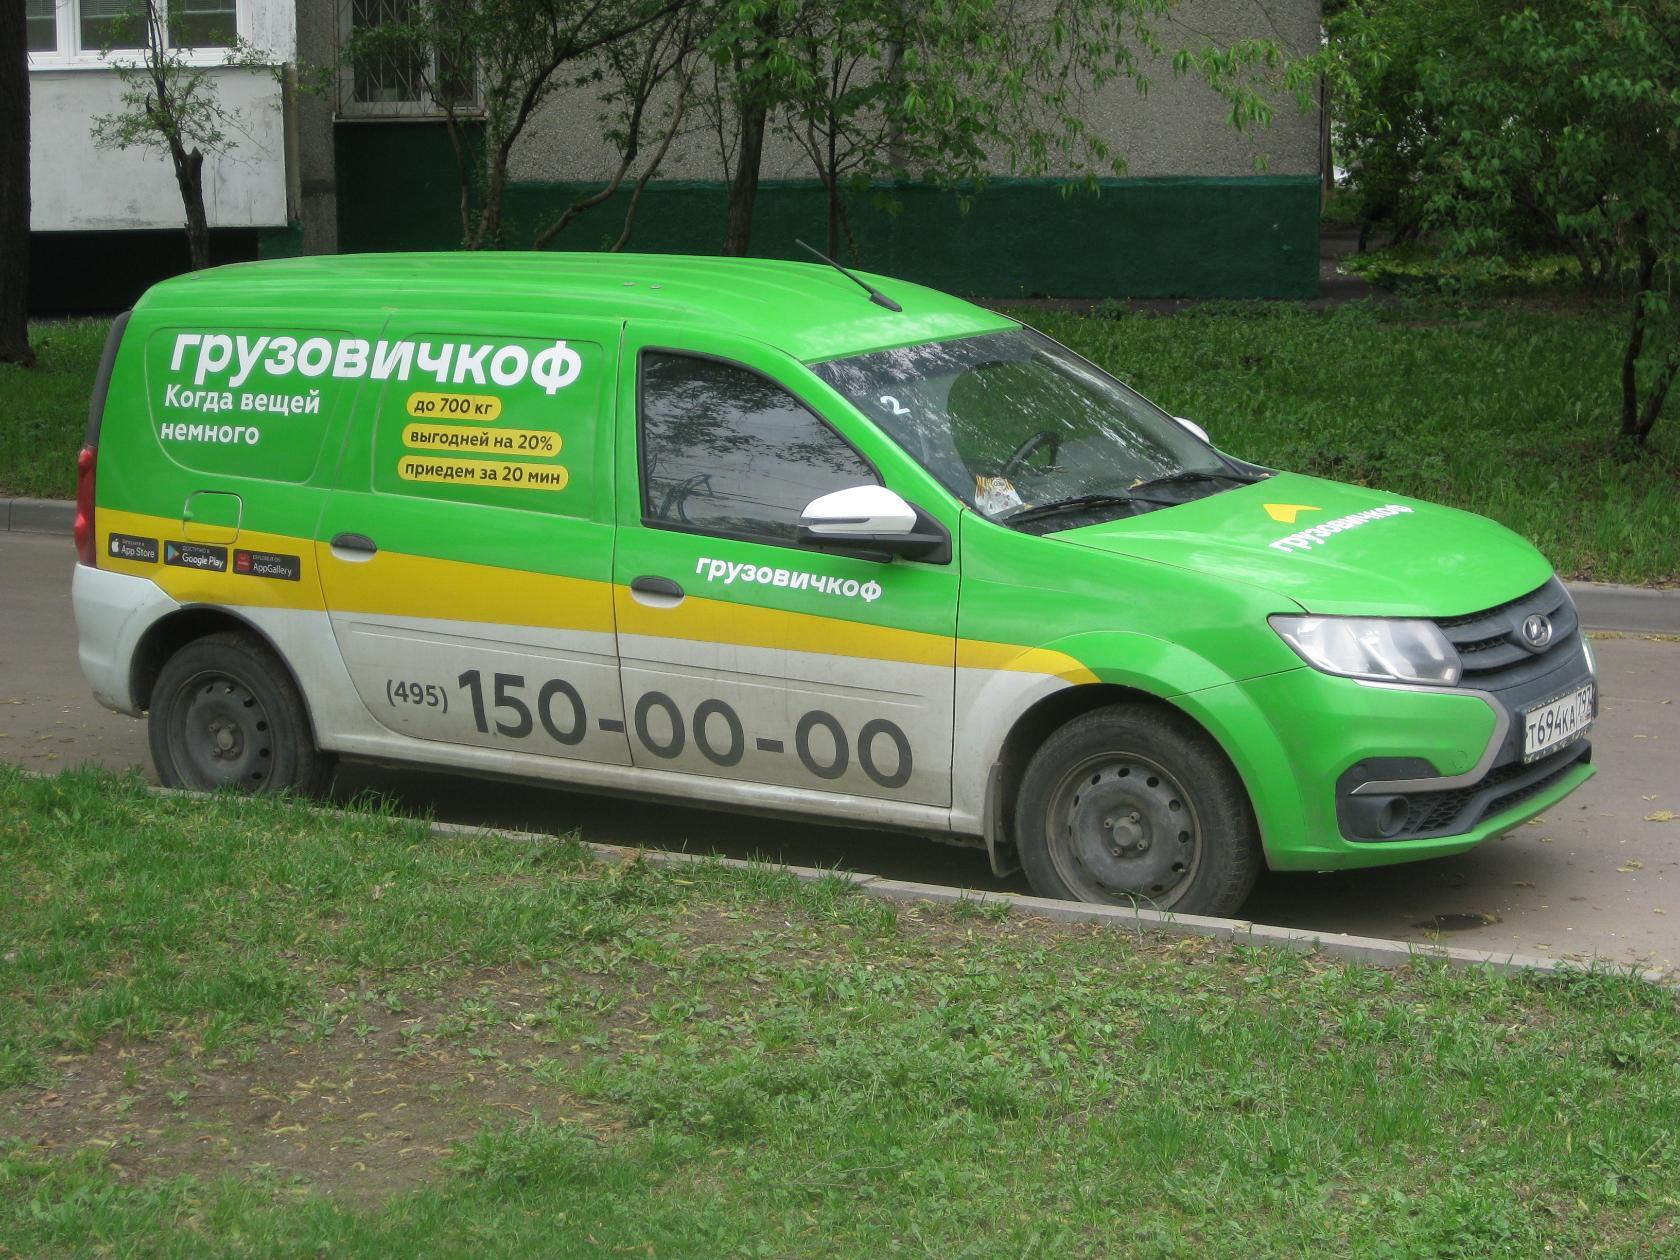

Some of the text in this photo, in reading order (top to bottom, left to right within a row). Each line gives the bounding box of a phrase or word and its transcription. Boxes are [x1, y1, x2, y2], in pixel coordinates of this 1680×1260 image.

[171, 333, 582, 395] грузовичкоф
[164, 384, 320, 415] Когда вещей
[414, 397, 493, 416] до 700 кг
[880, 395, 911, 415] 2
[160, 422, 260, 445] немного
[410, 429, 554, 452] выгодней на 20%
[405, 461, 561, 486] приедем за 20 мин
[121, 544, 155, 559] App Store
[182, 553, 224, 569] Google Play
[253, 560, 293, 577] AppGallery
[696, 557, 883, 603] грузовичкоф
[385, 669, 913, 790] (495) 150-00-00
